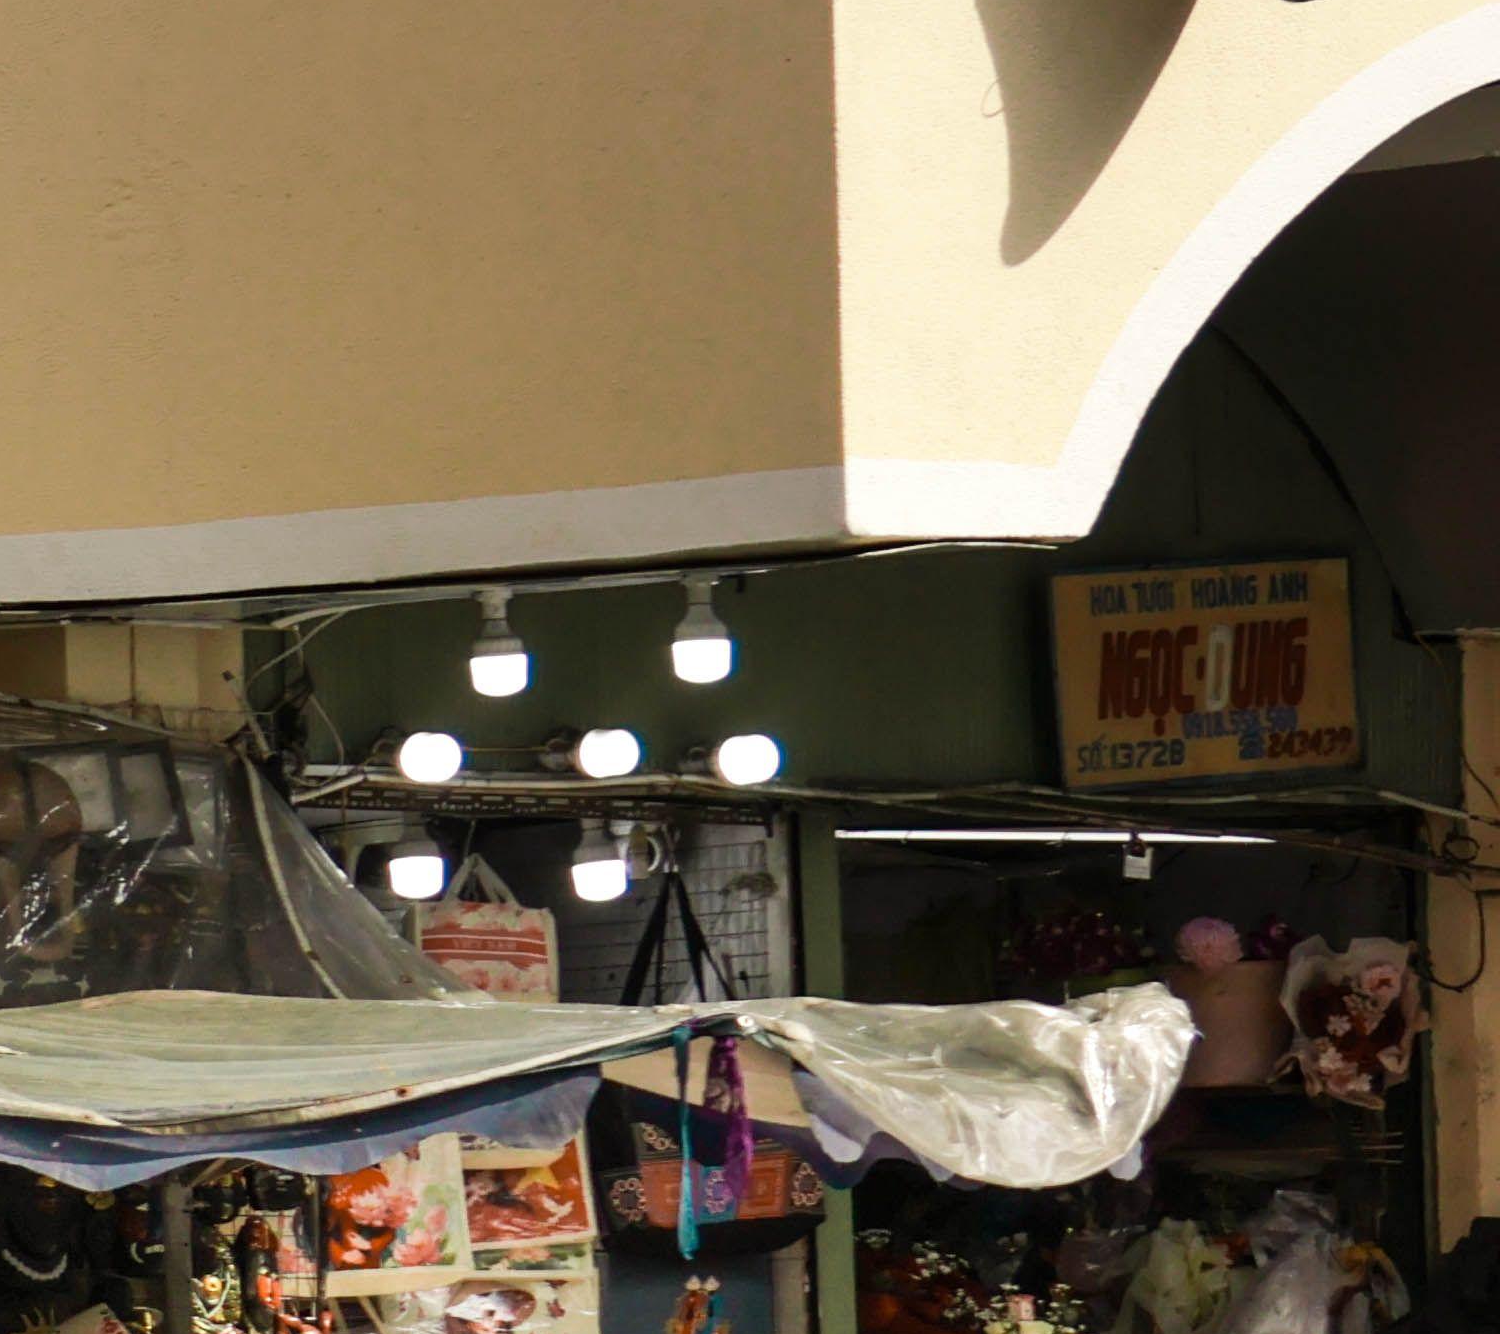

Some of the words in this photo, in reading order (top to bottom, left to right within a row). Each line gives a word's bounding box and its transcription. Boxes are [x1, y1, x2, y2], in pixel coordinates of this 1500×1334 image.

[1090, 584, 1127, 616] HOA
[1191, 568, 1258, 608] HOÀNG
[1268, 571, 1308, 603] ANH
